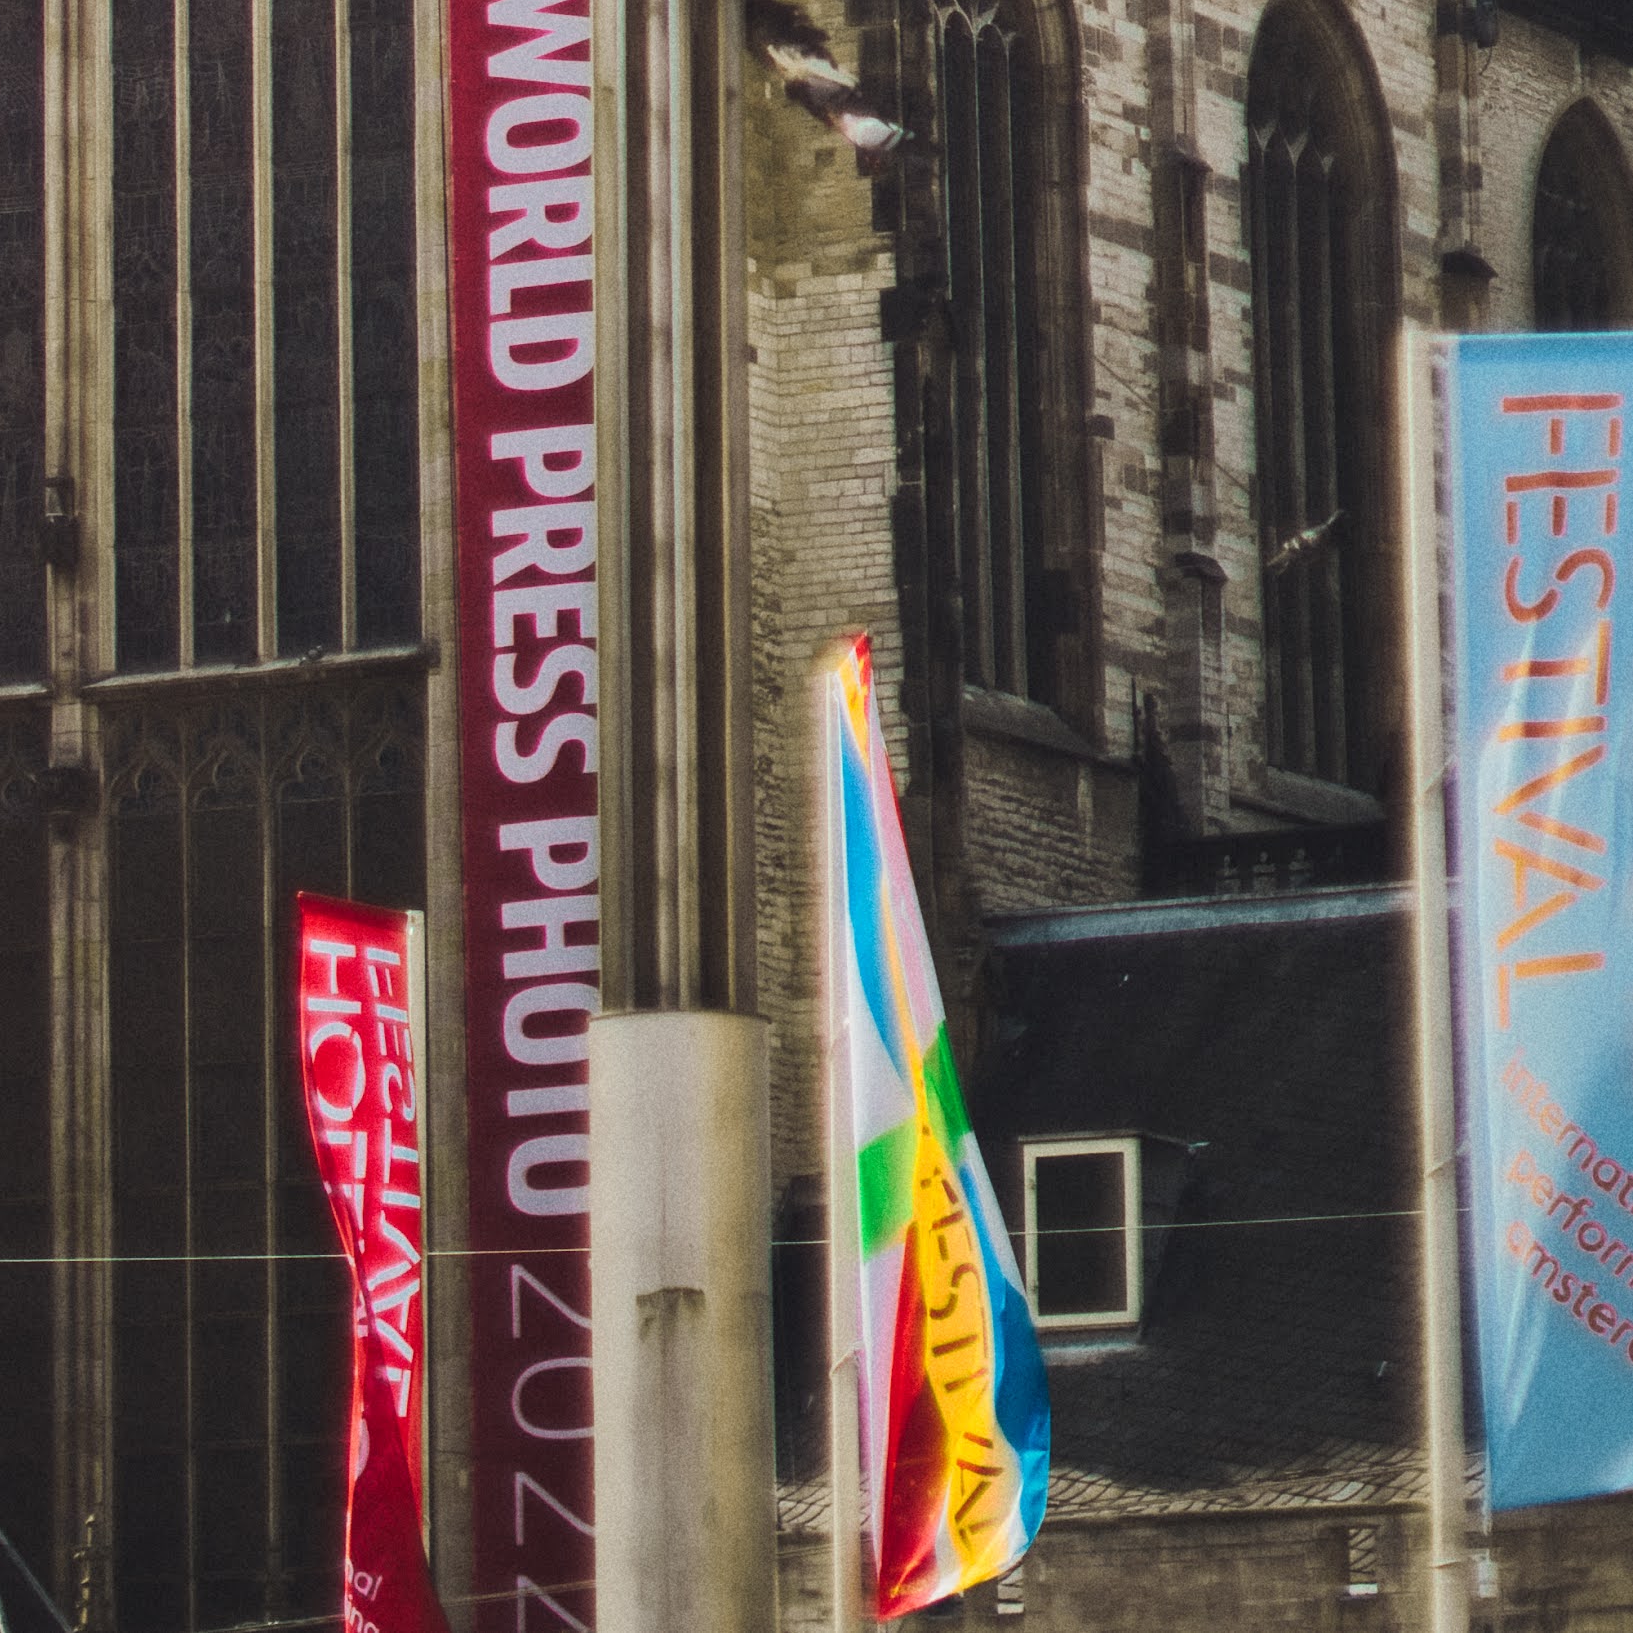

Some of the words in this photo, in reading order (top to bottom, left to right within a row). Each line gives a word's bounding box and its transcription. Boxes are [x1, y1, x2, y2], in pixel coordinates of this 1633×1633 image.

[487, 421, 599, 786] PRESS
[1492, 393, 1623, 1030] FESTIVAL
[1505, 1219, 1633, 1365] amster
